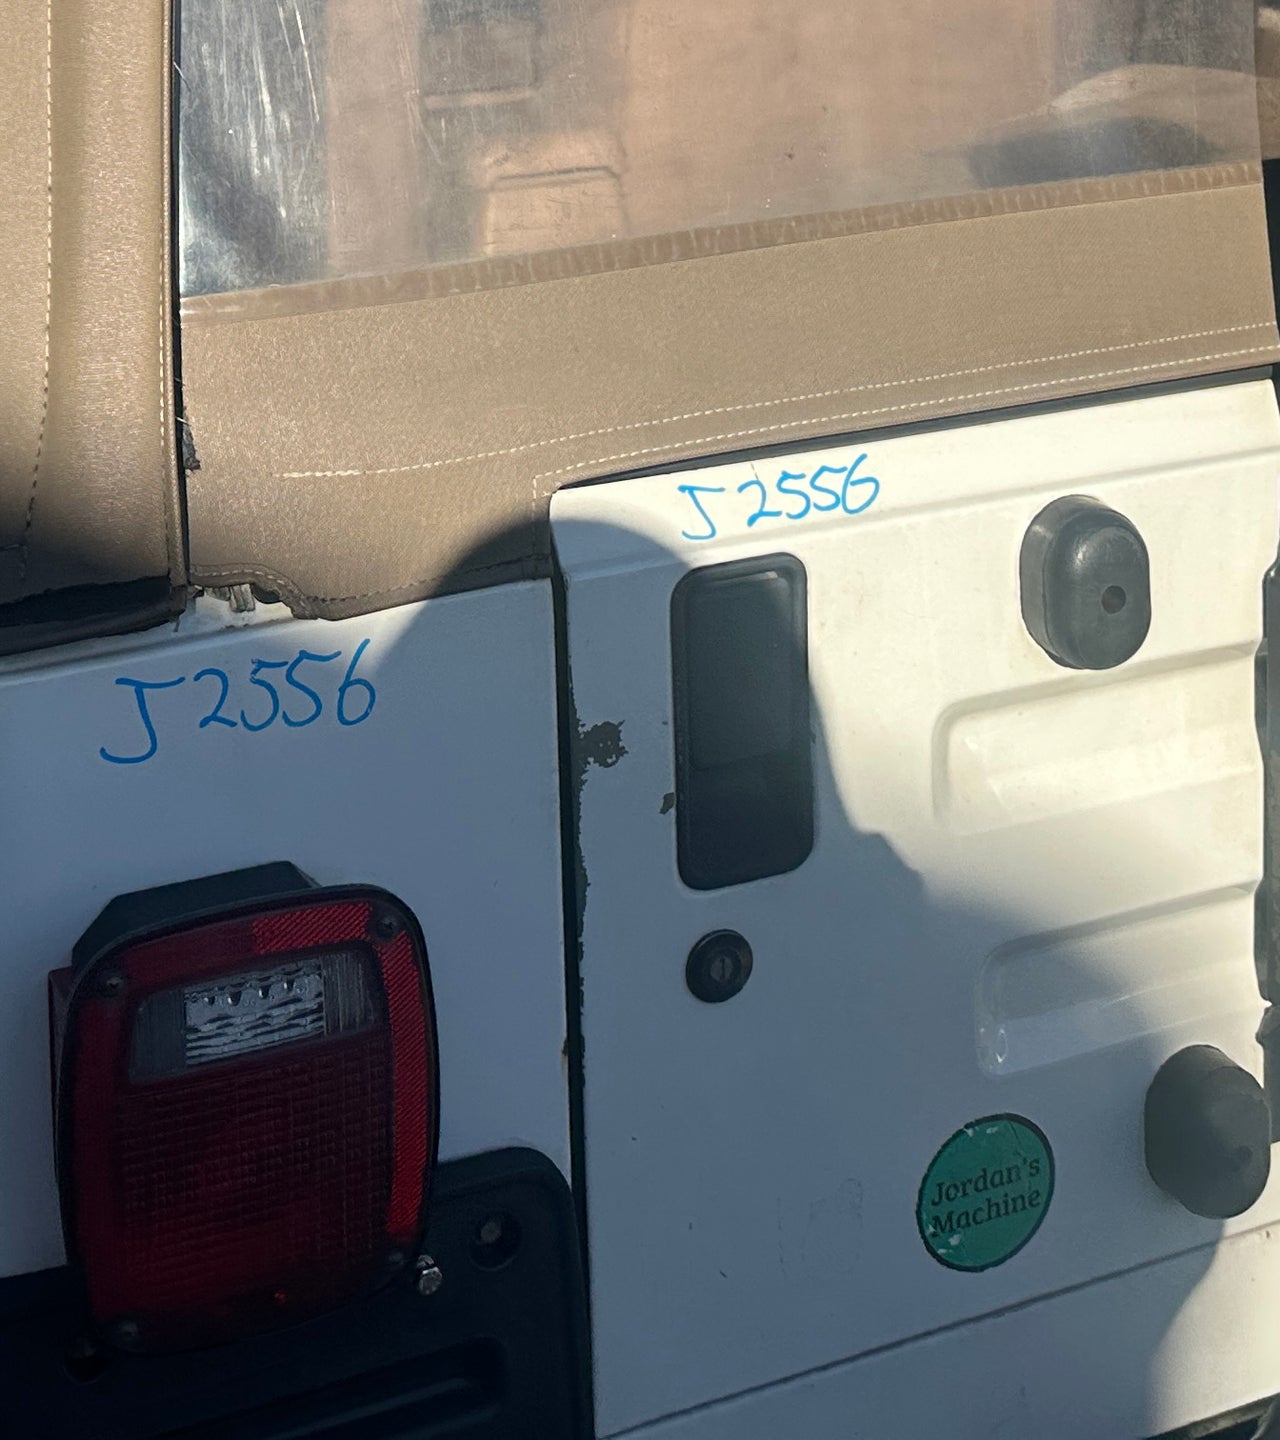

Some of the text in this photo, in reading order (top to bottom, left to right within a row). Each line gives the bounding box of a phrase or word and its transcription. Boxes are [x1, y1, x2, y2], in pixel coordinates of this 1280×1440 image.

[677, 452, 881, 541] J2556
[99, 637, 377, 765] J2556
[930, 1156, 1041, 1207] Jordan's
[930, 1189, 1042, 1238] Machine
